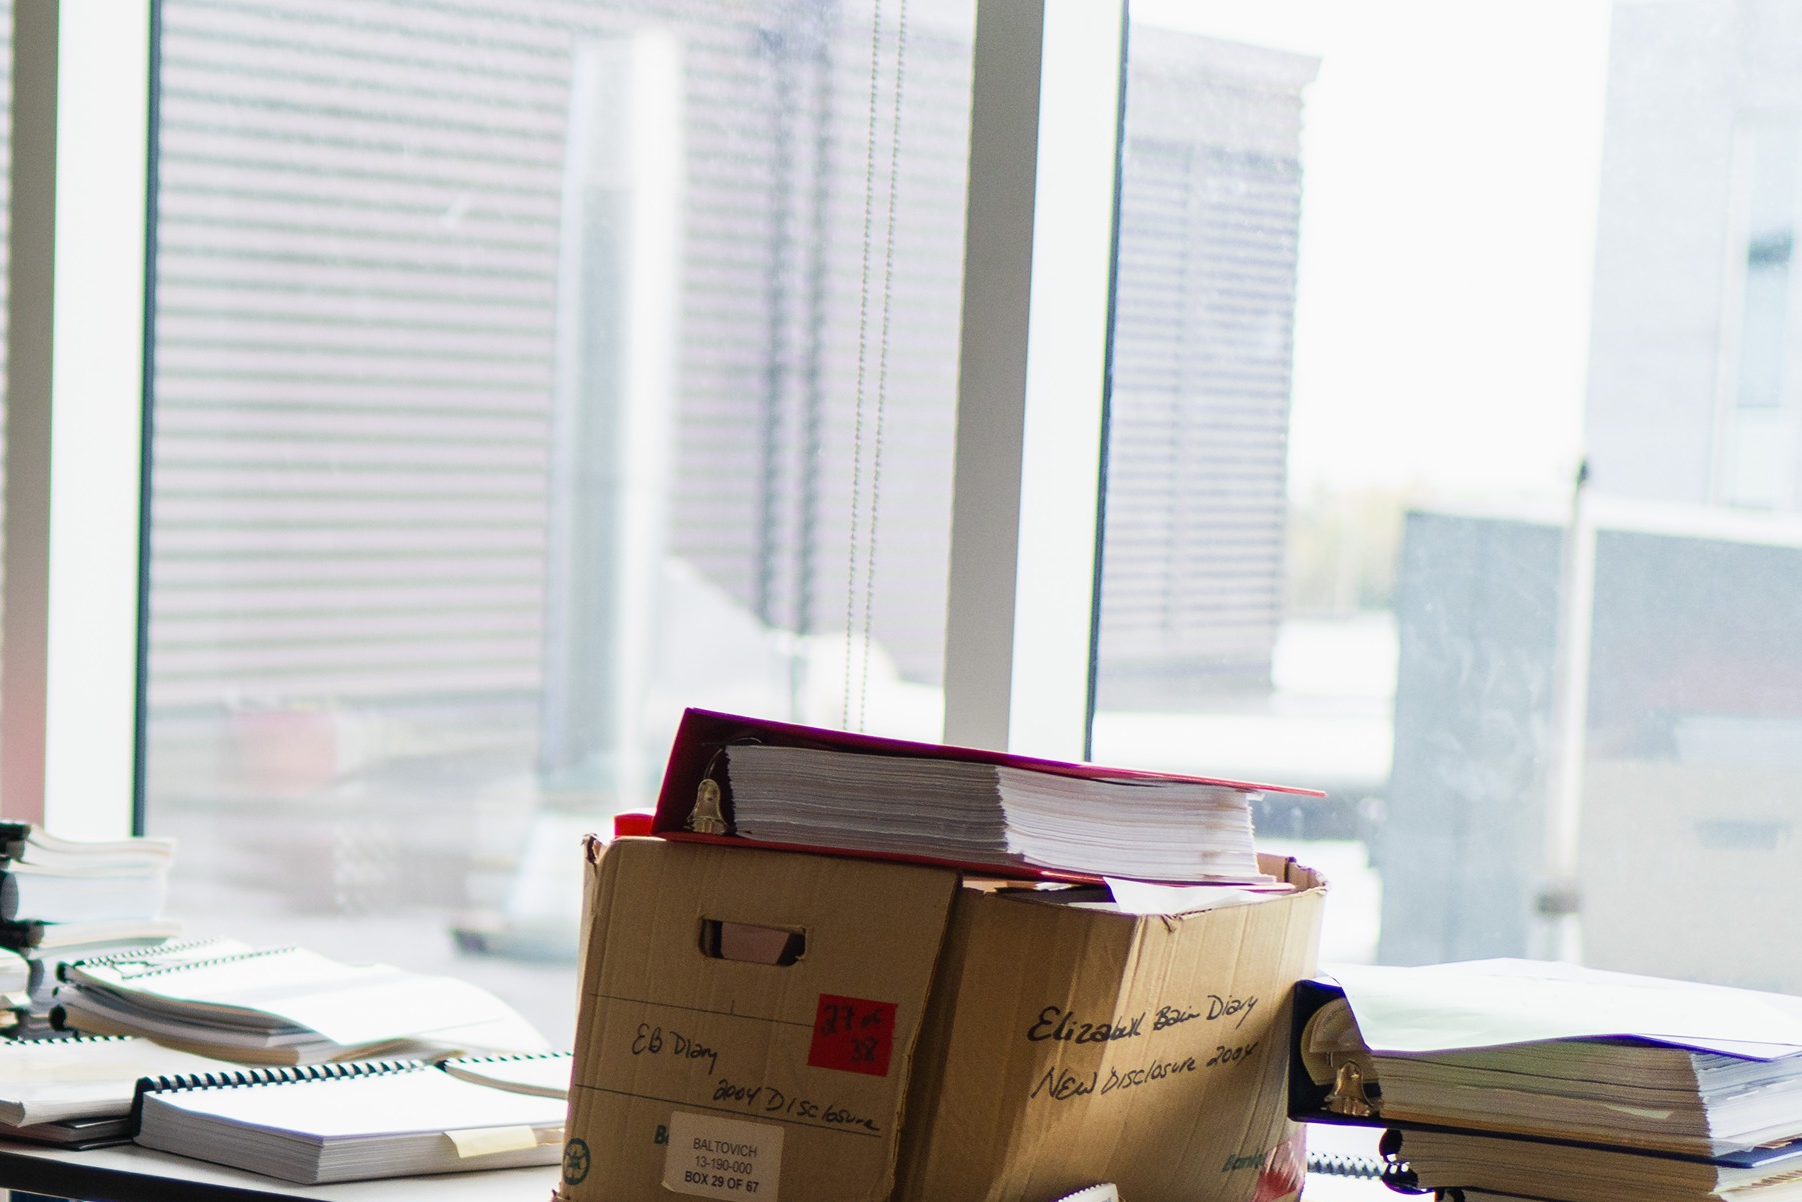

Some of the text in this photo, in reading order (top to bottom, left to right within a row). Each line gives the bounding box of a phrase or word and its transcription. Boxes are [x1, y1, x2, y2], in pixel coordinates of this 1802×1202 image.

[693, 1137, 758, 1158] BALTOVICH
[694, 1155, 753, 1175] 13-190-000
[684, 1170, 760, 1194] BOX 29 OF 67
